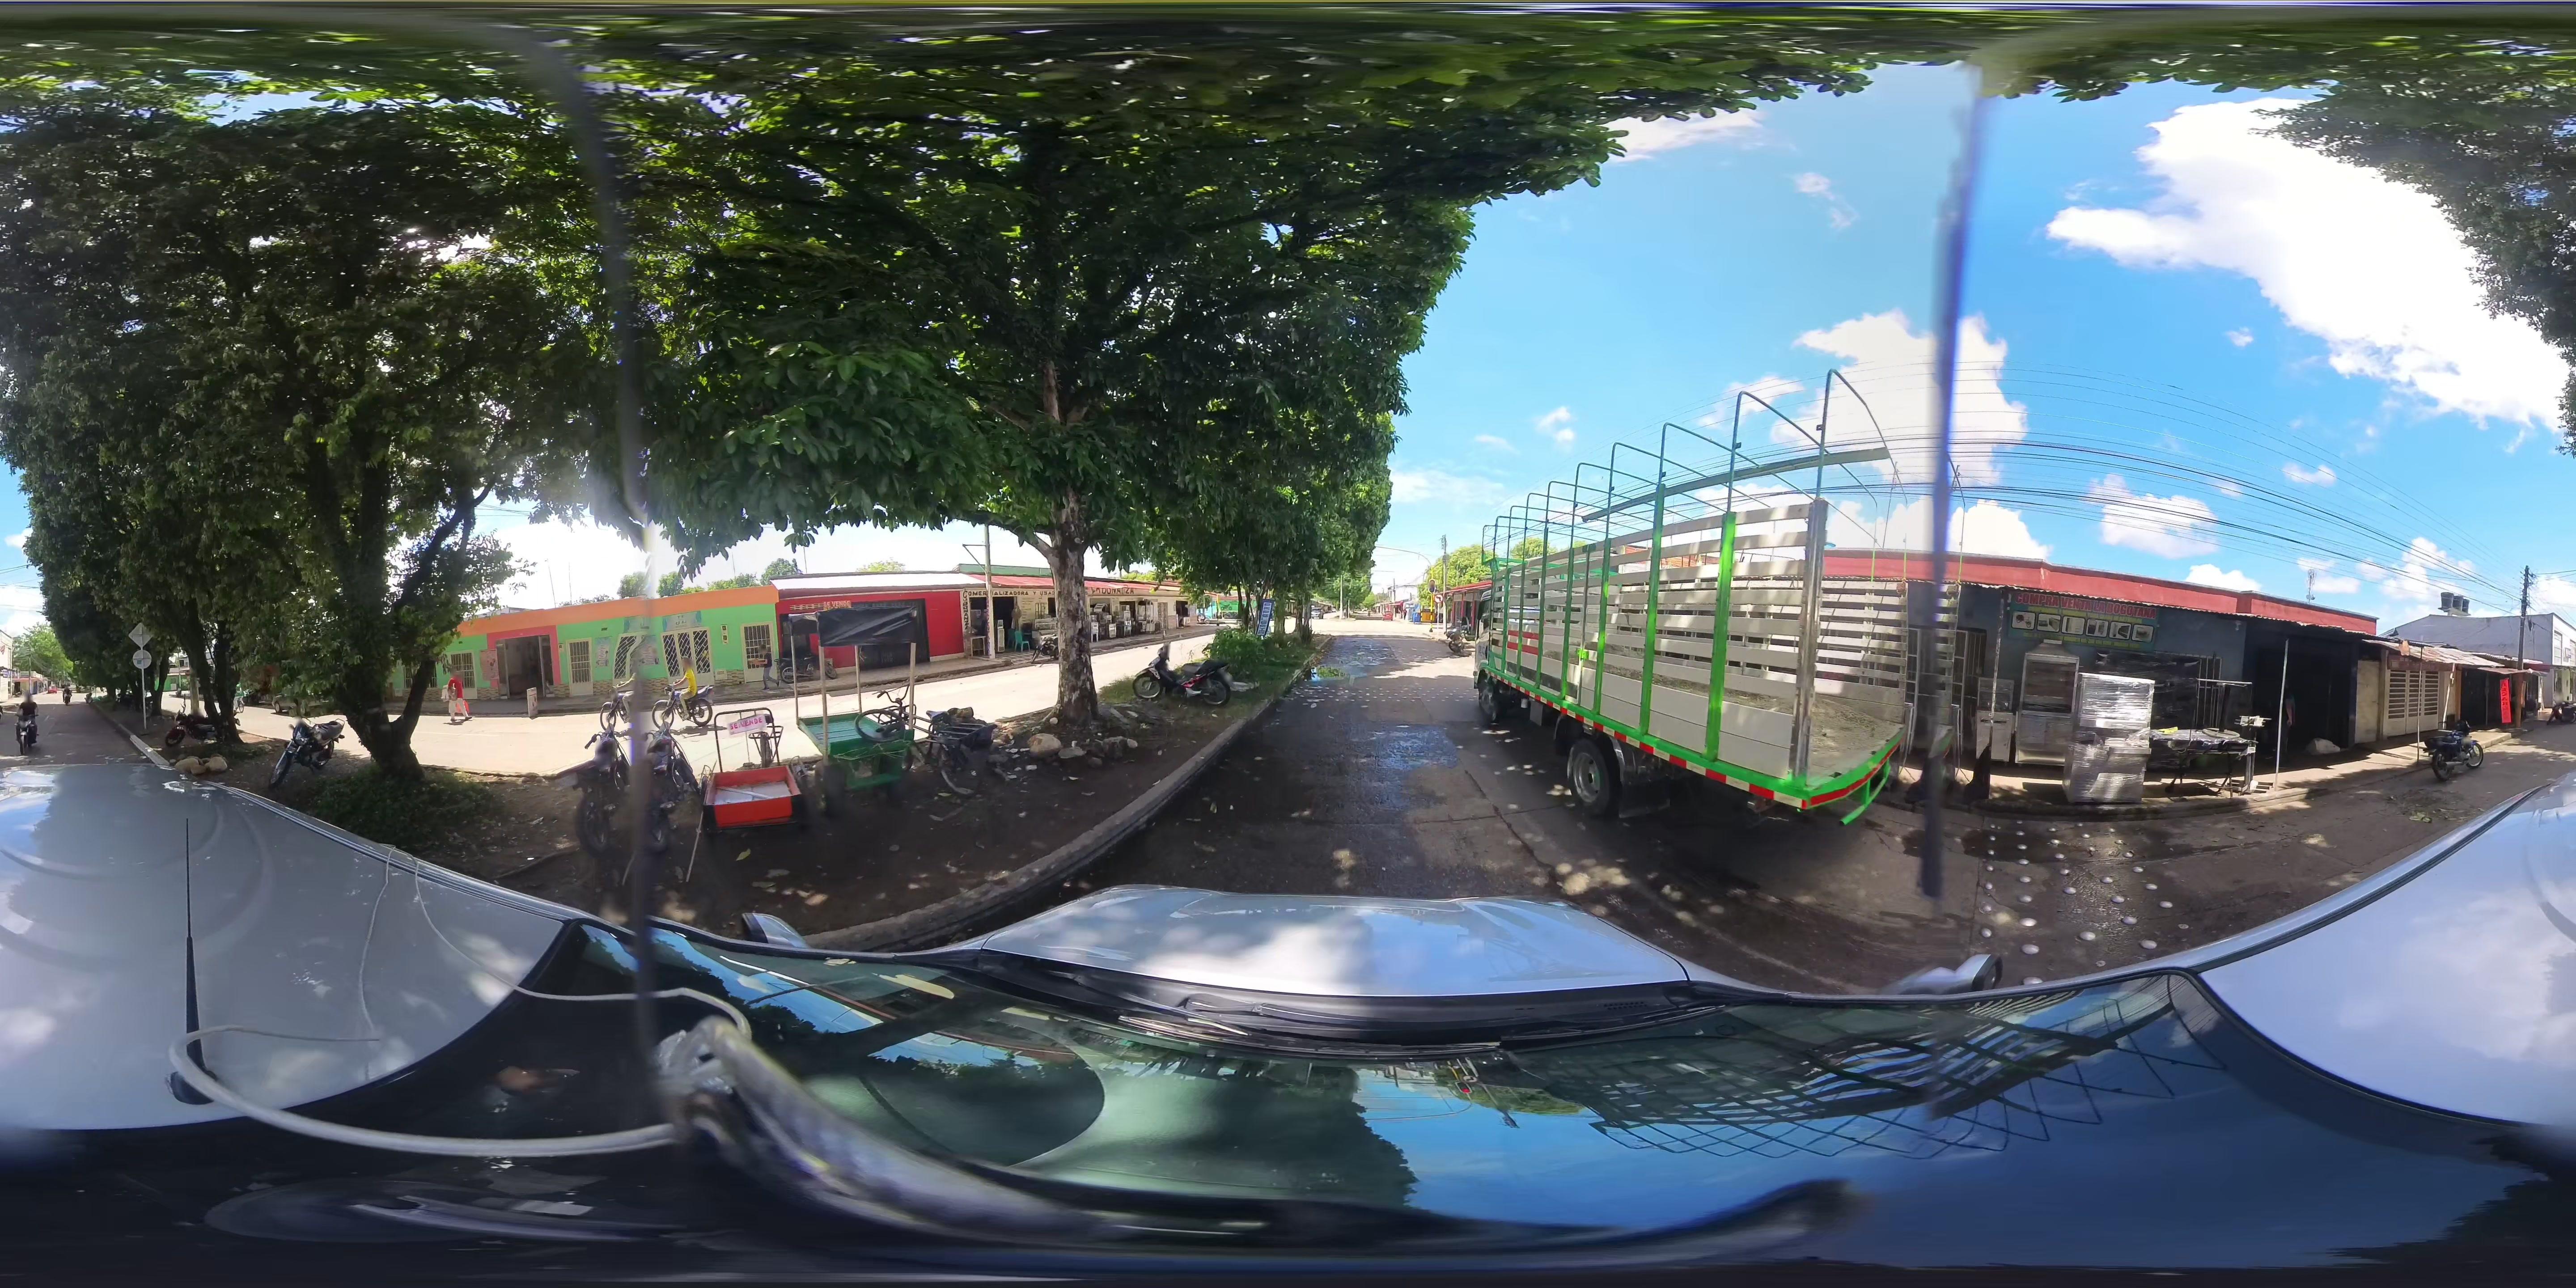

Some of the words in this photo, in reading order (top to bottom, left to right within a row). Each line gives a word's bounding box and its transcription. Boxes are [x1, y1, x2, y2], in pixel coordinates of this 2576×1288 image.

[2015, 593, 2059, 608] COMPRA
[2060, 596, 2092, 612] VENTA
[2092, 600, 2106, 613] LA
[741, 717, 763, 727] VENDE
